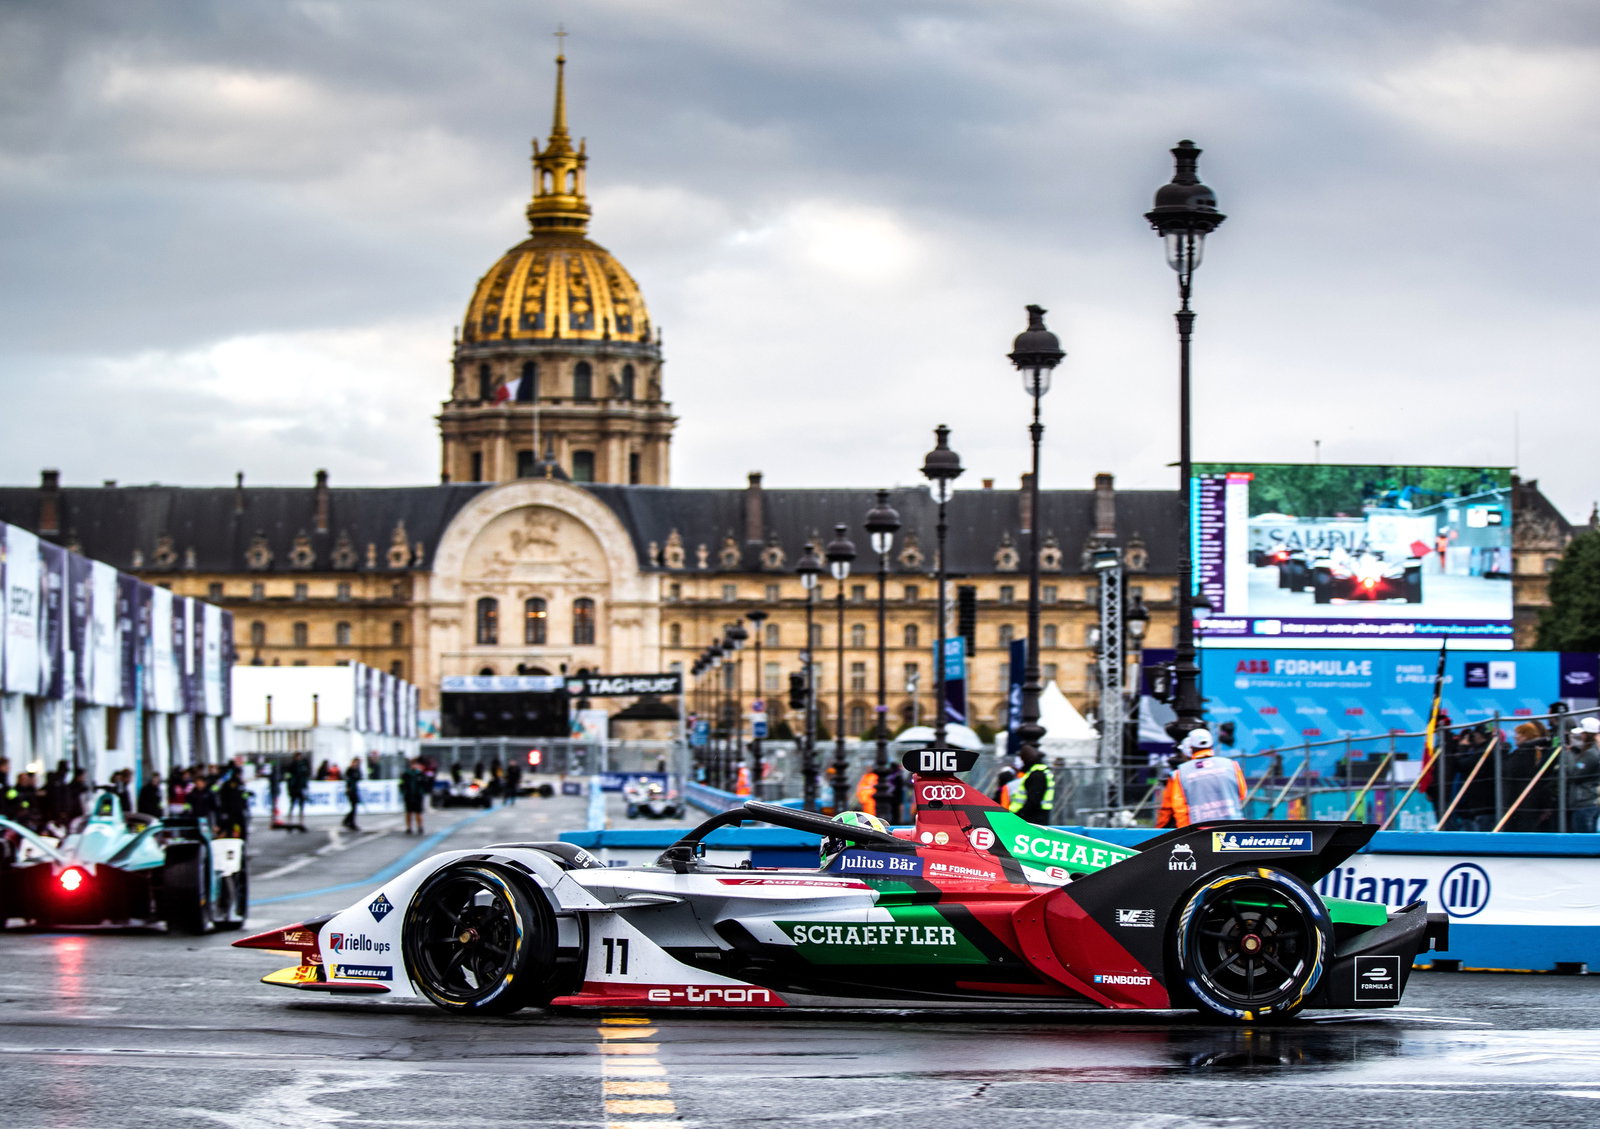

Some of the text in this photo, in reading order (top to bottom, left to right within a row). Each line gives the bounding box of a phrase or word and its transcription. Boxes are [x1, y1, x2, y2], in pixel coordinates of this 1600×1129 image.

[1235, 660, 1270, 673] ABB
[920, 751, 957, 771] DIG
[1241, 837, 1304, 846] MICHELIN
[840, 855, 917, 871] Julius Bär
[929, 863, 947, 871] ABB
[1168, 861, 1197, 871] HYLA
[371, 903, 389, 913] LGT
[793, 924, 957, 945] SCHAEFFLER
[345, 934, 391, 954] riello ups
[602, 937, 629, 975] 11
[347, 969, 387, 977] MICHELIN
[1102, 975, 1153, 985] FANBOOST
[648, 985, 770, 1002] e-tron
